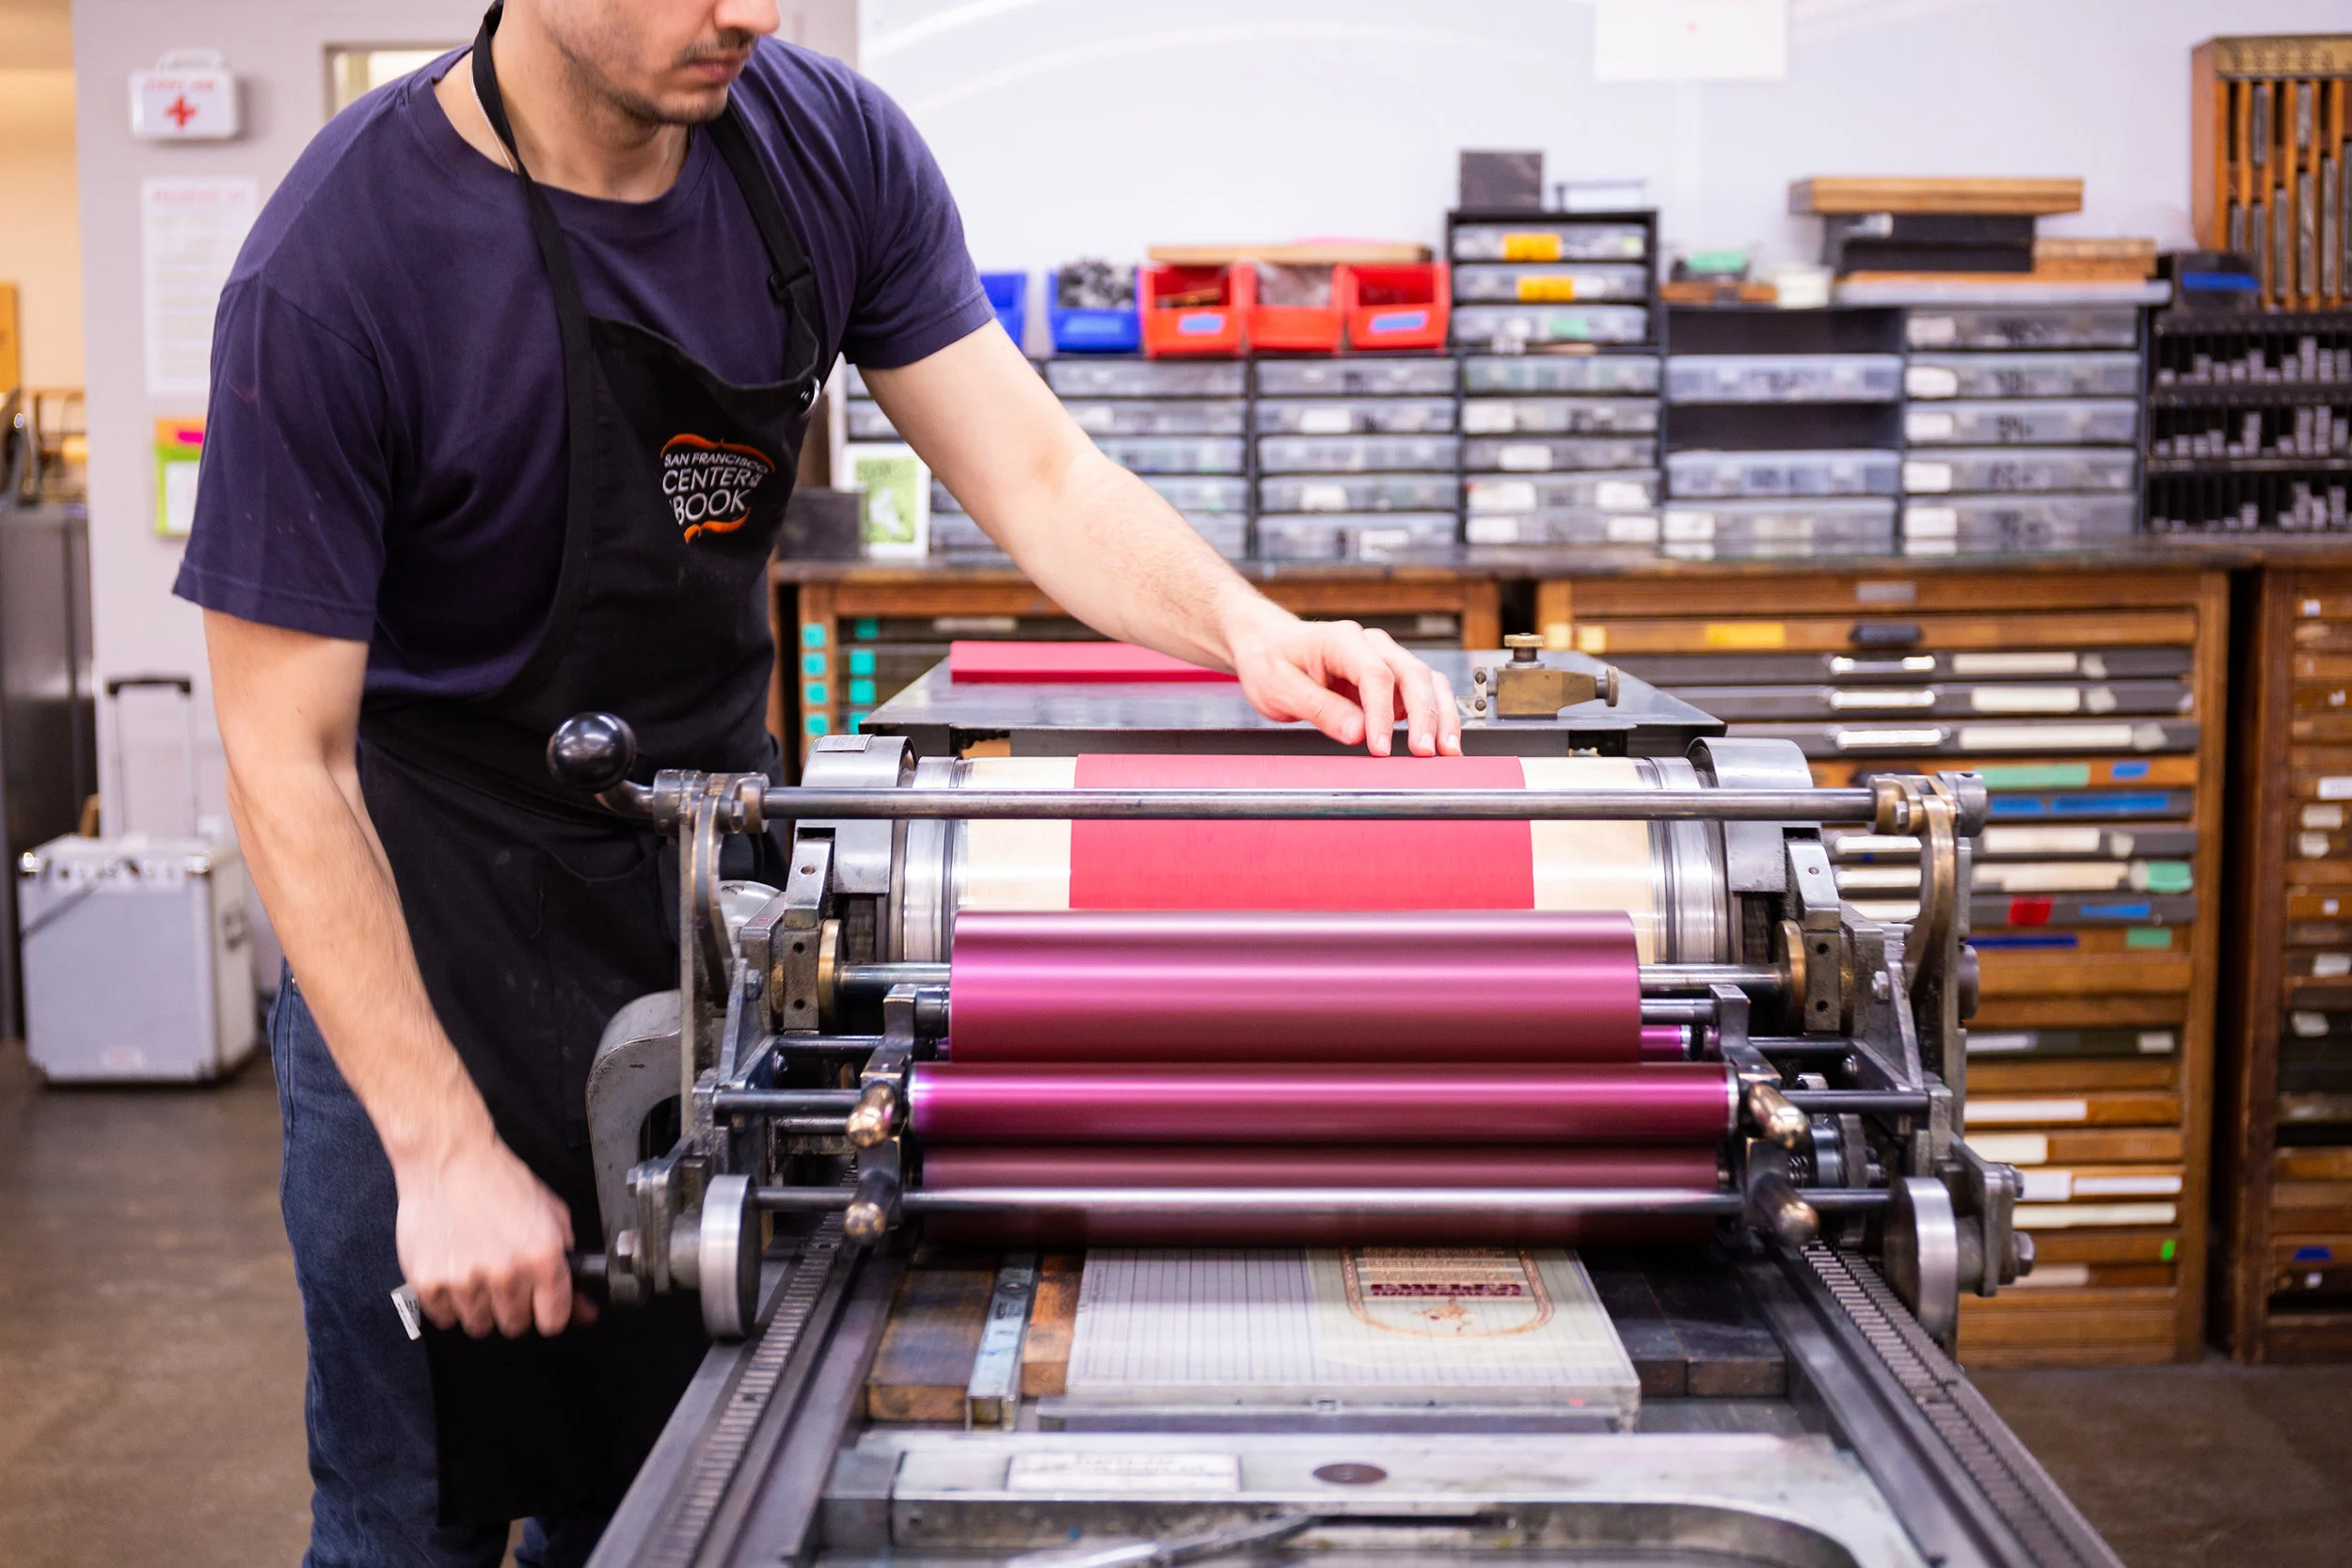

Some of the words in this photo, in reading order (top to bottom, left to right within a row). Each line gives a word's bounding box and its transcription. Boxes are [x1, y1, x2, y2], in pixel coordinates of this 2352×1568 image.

[664, 452, 690, 467] SAN
[691, 451, 769, 474] FRANCISCO
[662, 467, 751, 495] CENTER
[674, 489, 751, 525] BOOK
